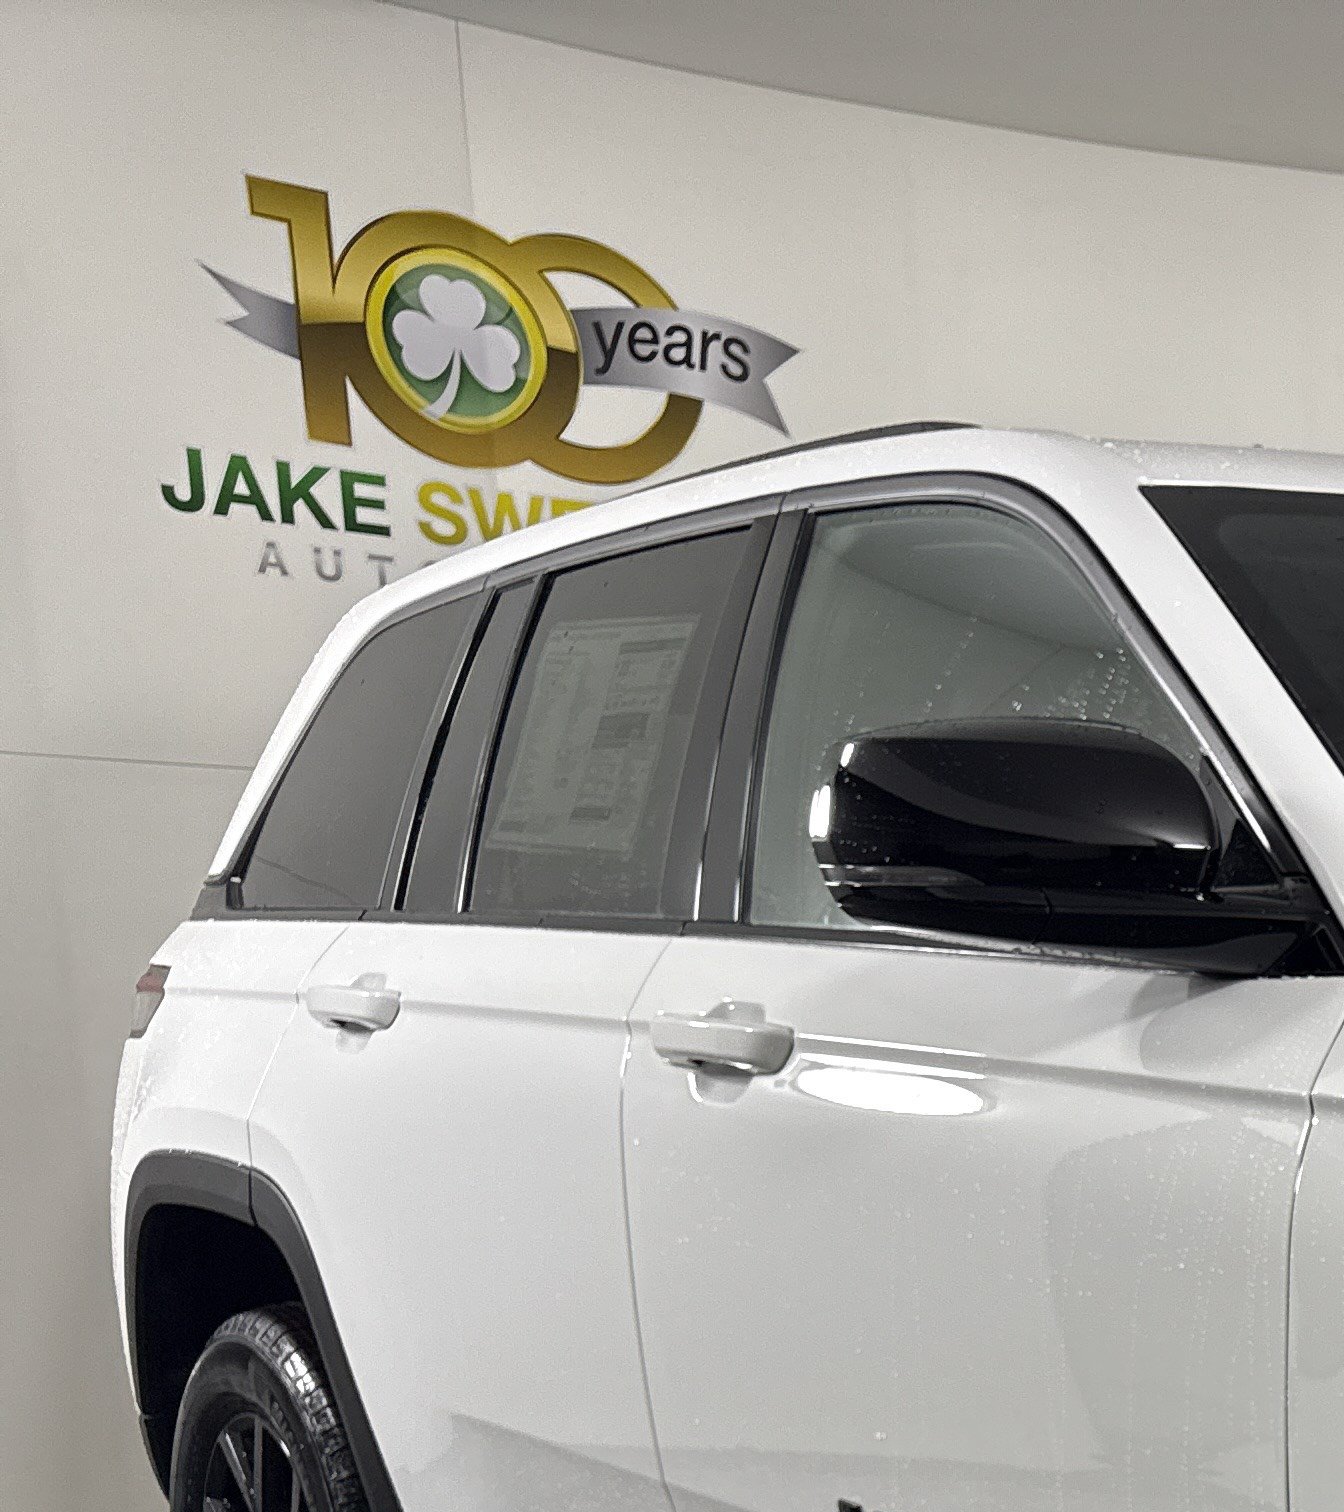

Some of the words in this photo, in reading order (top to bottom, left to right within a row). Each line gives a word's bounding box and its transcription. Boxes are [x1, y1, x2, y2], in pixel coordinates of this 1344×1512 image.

[245, 174, 703, 484] 100
[594, 312, 752, 382] years
[161, 447, 391, 537] JAKE
